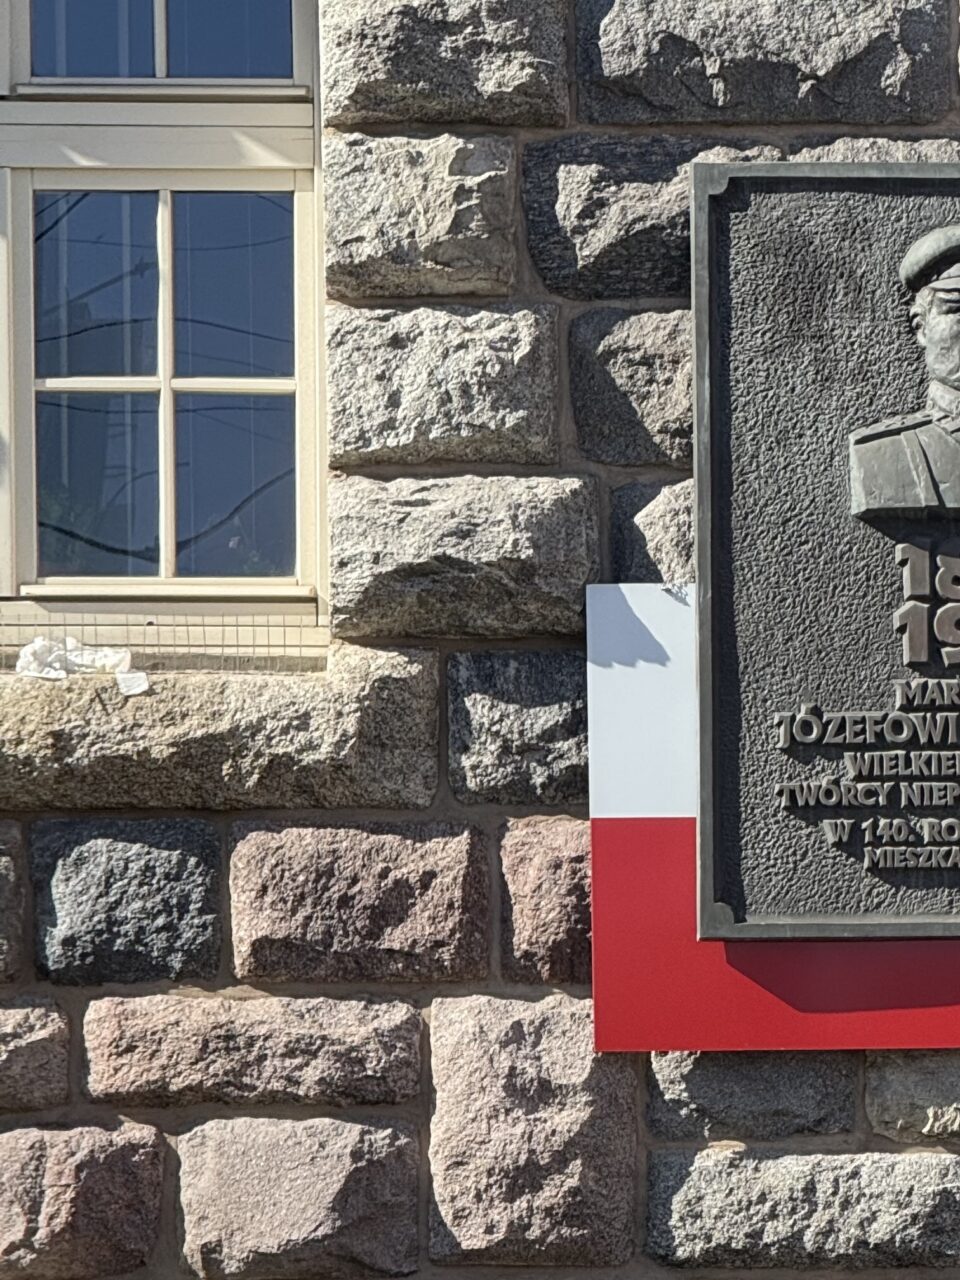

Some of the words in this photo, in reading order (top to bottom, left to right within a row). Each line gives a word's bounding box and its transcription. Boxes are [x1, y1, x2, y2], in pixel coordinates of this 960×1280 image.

[774, 703, 959, 748] JÓZEFOWI
[775, 776, 895, 808] TWÓRCY
[822, 818, 855, 847] W
[861, 817, 916, 845] 140.
